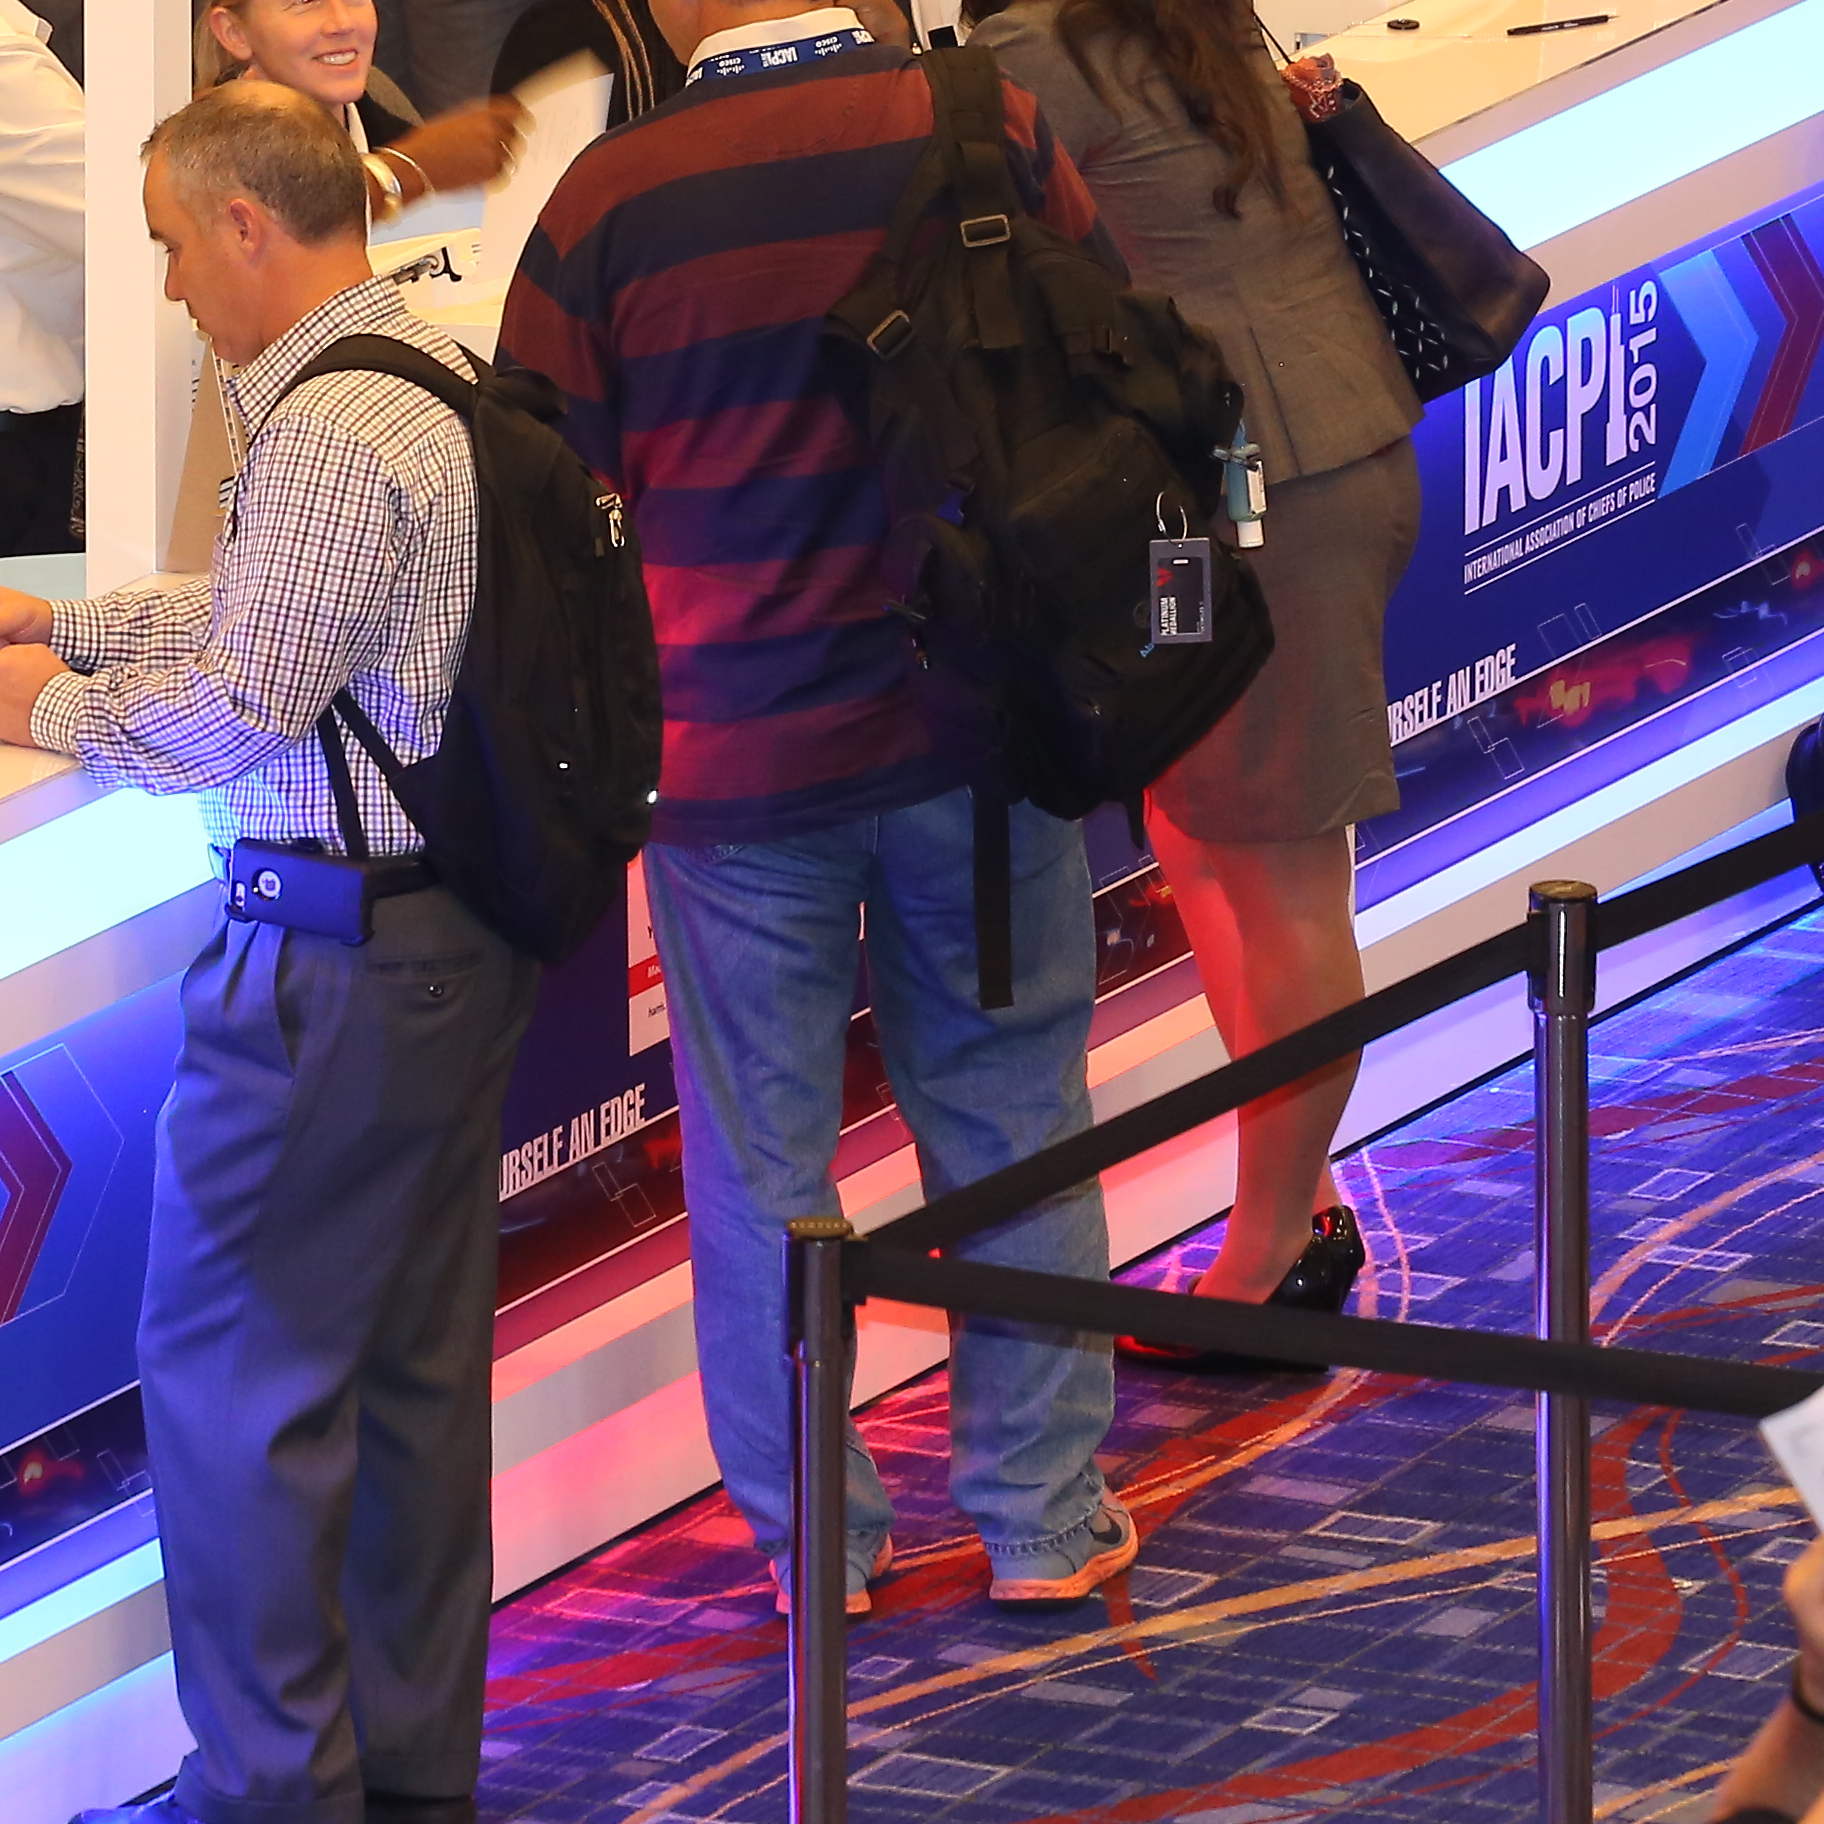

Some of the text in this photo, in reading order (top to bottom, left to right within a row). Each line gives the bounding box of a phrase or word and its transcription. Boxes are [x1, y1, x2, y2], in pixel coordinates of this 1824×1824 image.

[719, 57, 741, 67] CISCO
[815, 36, 838, 48] CISCO
[1628, 280, 1658, 453] 2015
[1464, 472, 1657, 585] INTERNATIONAL ASSOCIATION OF CHIEFS OF POLICE
[1446, 666, 1470, 716] AN
[1475, 643, 1517, 703] EDGE
[569, 1109, 594, 1164] AN
[600, 1082, 646, 1147] EDGE
